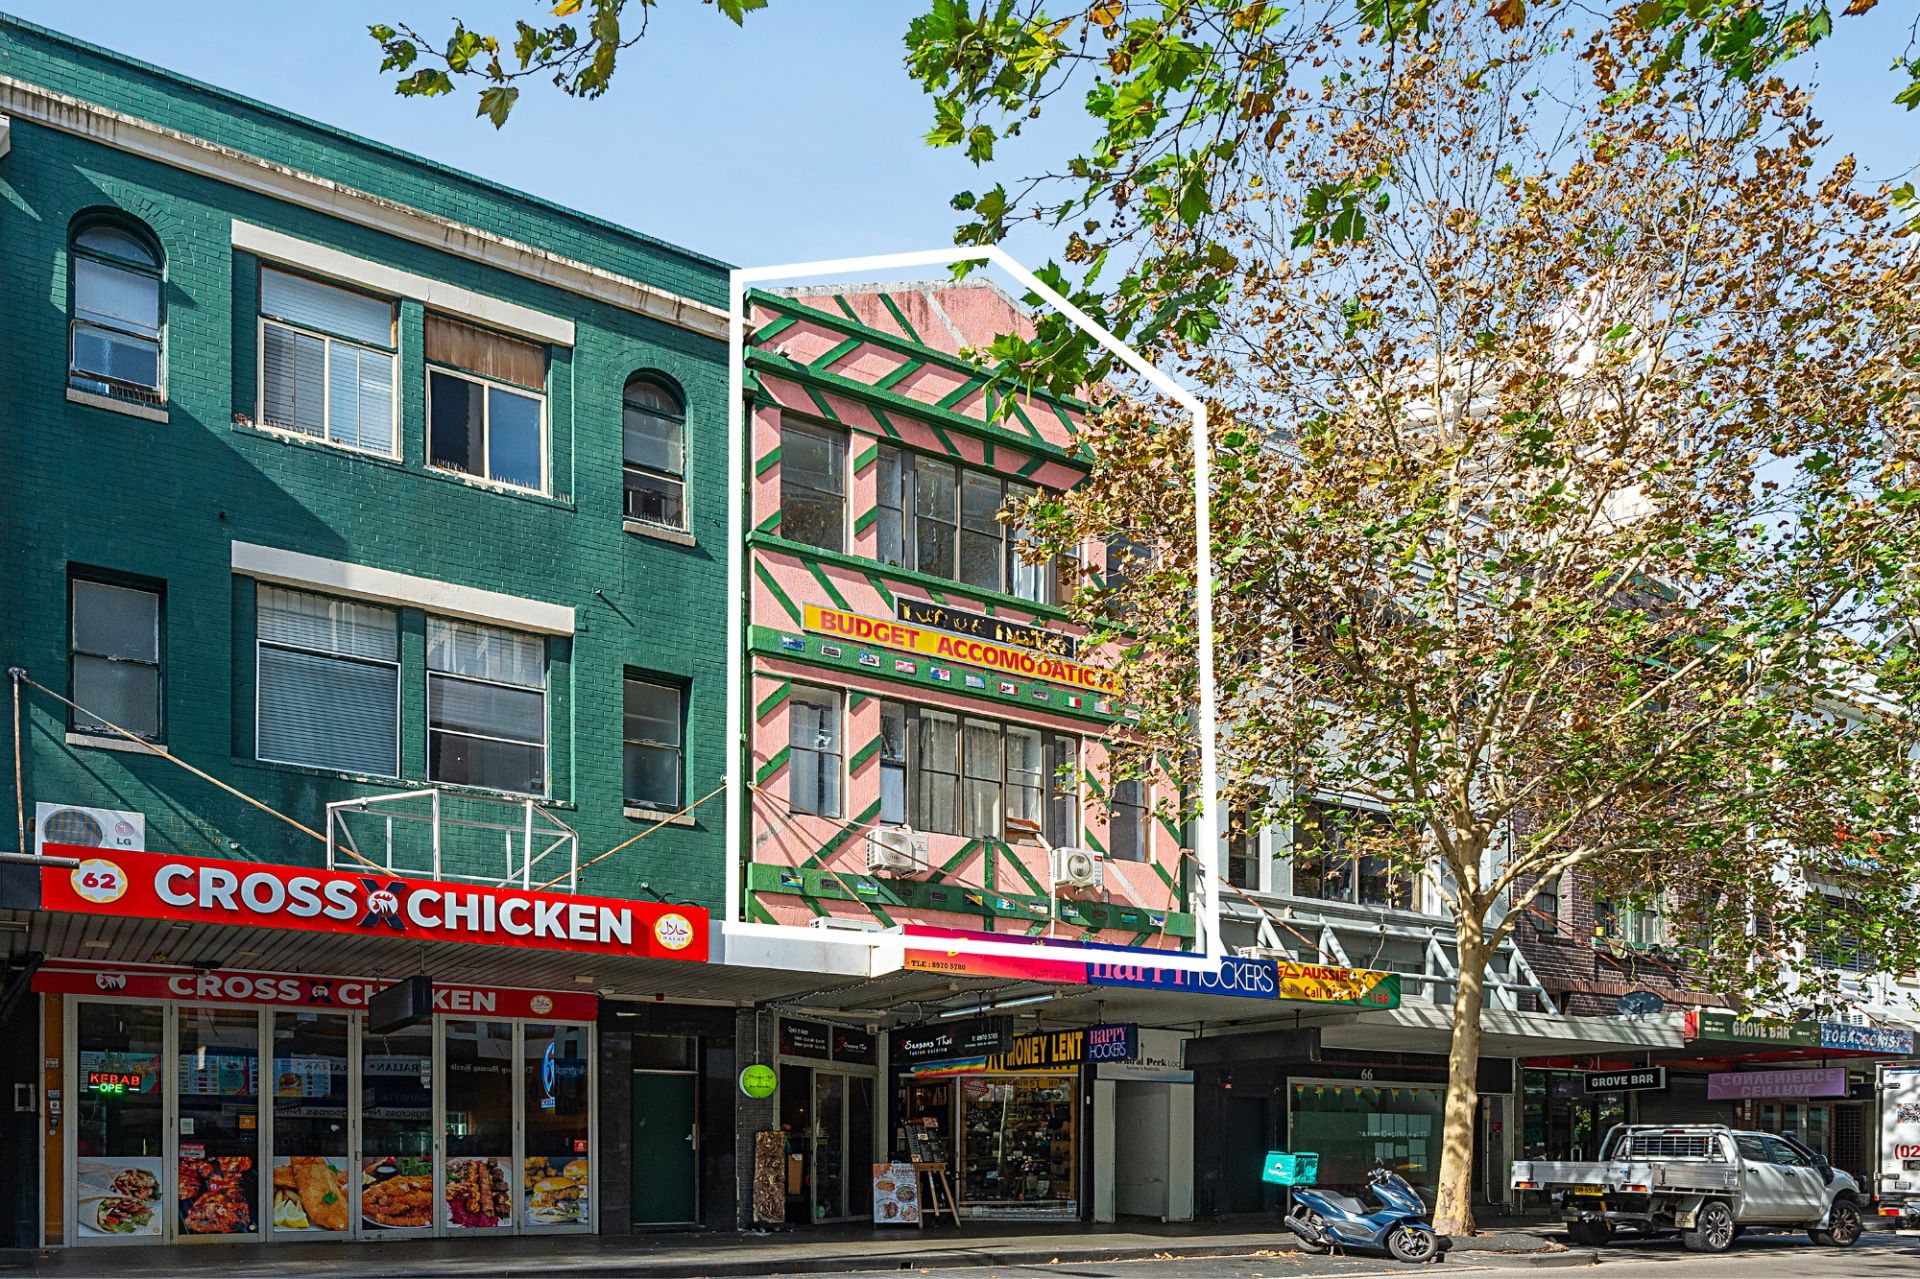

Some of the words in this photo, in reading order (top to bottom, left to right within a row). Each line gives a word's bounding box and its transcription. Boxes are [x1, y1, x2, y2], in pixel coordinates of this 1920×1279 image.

[820, 610, 920, 649] BUDGET
[116, 837, 132, 846] LG
[82, 872, 117, 890] 62
[154, 863, 358, 920] CROSS
[406, 888, 632, 945] CHICKEN
[1301, 966, 1348, 982] AUSSIE
[168, 975, 301, 1001] CROSS
[338, 983, 496, 1012] CHKEN
[1304, 986, 1322, 998] Call
[1368, 993, 1389, 1004] 1188
[1733, 1021, 1767, 1038] GROVE
[1769, 1025, 1790, 1040] BAR
[904, 1039, 935, 1050] Seasons
[936, 1035, 953, 1046] Thai
[1007, 1035, 1048, 1066] MONEY
[1052, 1031, 1084, 1062] LENT
[1089, 1042, 1126, 1059] HOCKERS
[1147, 1058, 1167, 1066] Perk
[90, 1073, 140, 1086] KEBAB
[1361, 1068, 1373, 1080] 66
[1591, 1075, 1628, 1088] GROVE
[1630, 1073, 1654, 1086] BAR
